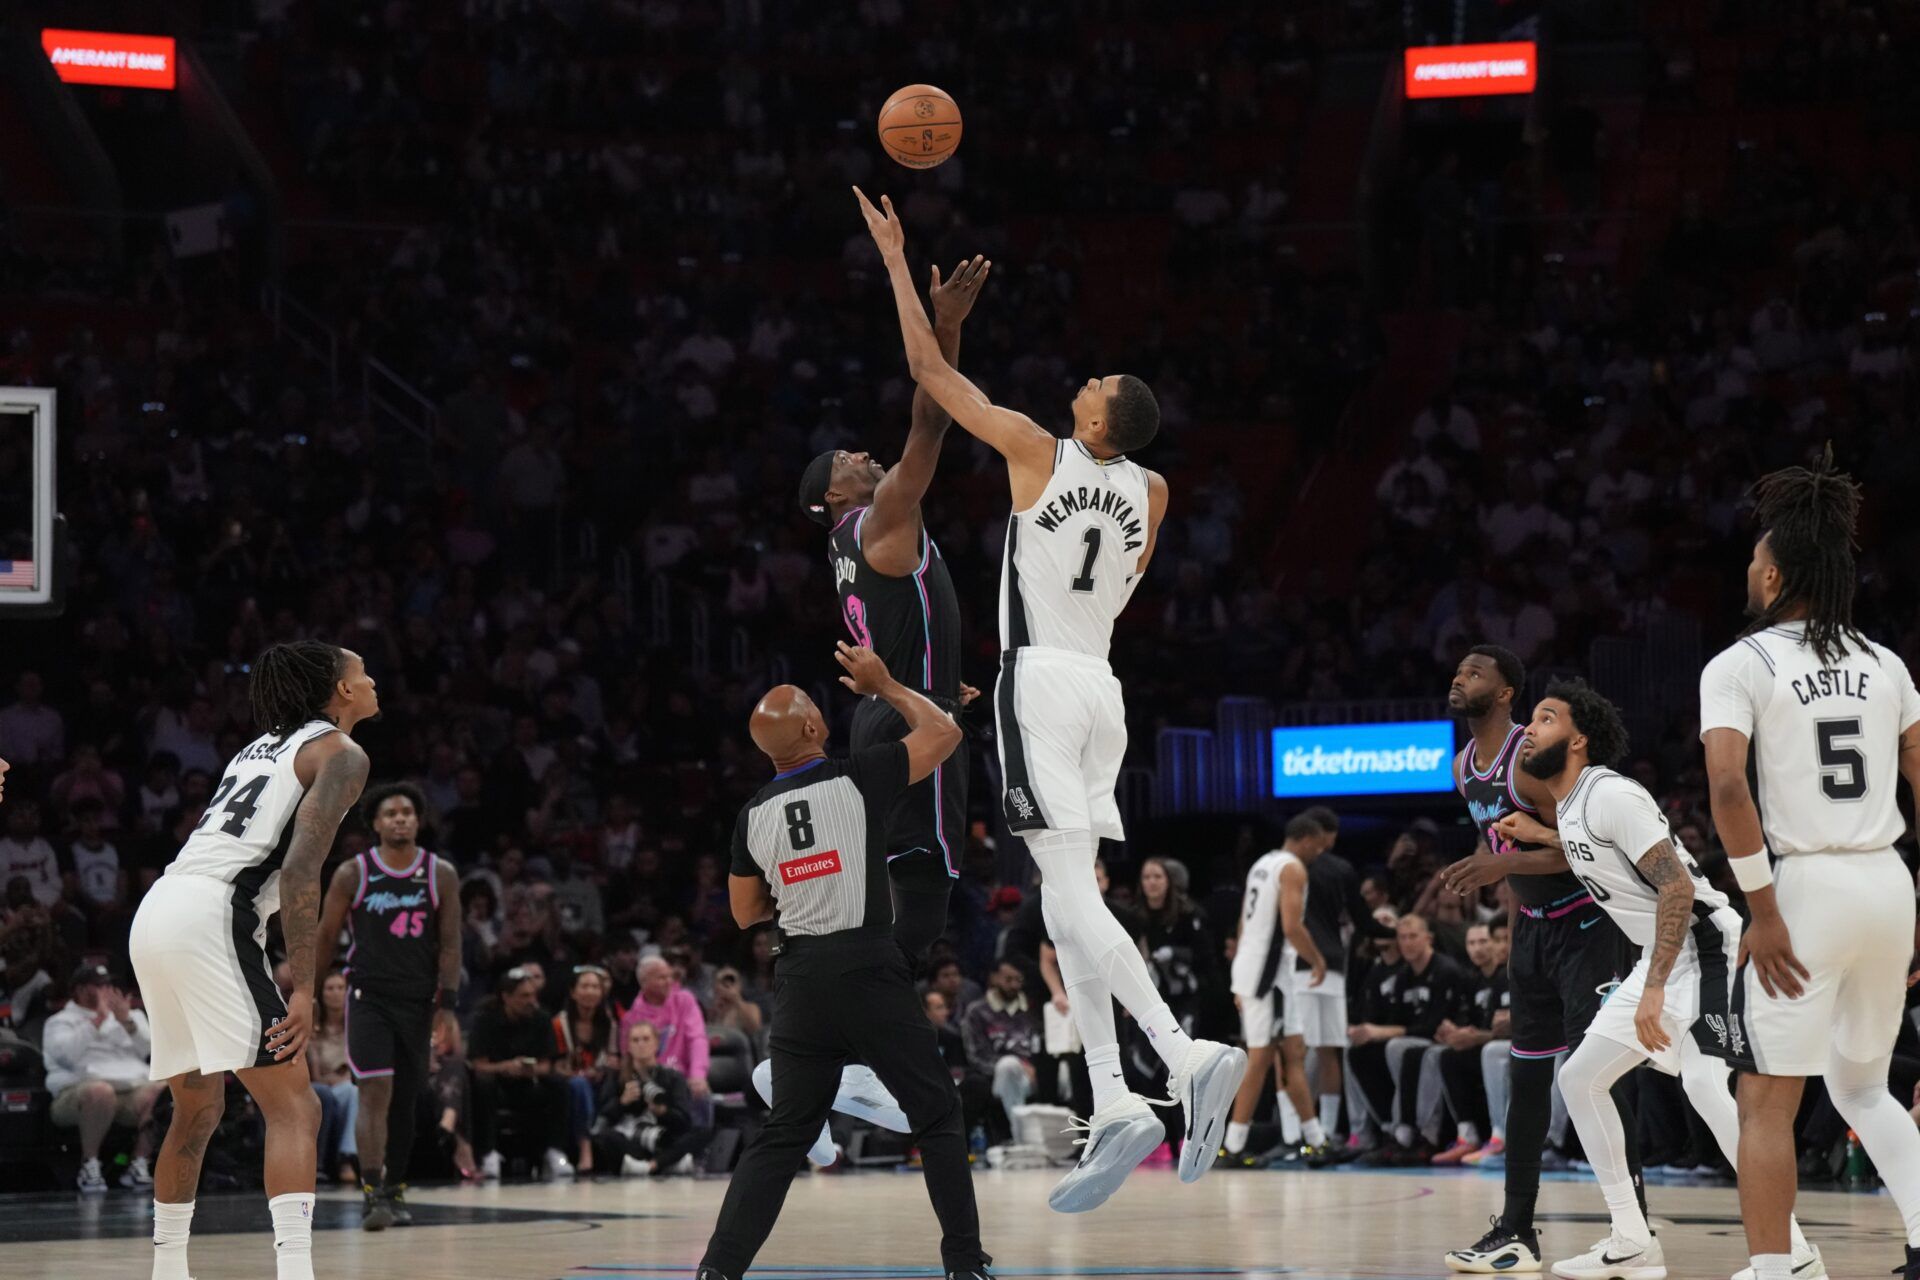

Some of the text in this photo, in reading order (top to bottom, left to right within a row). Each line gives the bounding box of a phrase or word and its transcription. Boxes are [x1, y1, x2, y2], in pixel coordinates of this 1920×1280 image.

[51, 47, 166, 71] AMERANT BANK
[1488, 59, 1527, 77] BANK
[1035, 487, 1142, 553] WEMBANYAMA
[1070, 526, 1103, 594] 1
[1791, 669, 1869, 706] CASTLE
[1282, 745, 1445, 776] ticketmaster
[1815, 717, 1869, 802] 5
[197, 774, 272, 839] 24
[784, 800, 815, 850] 8
[786, 858, 835, 878] Emirates
[390, 910, 427, 938] 45
